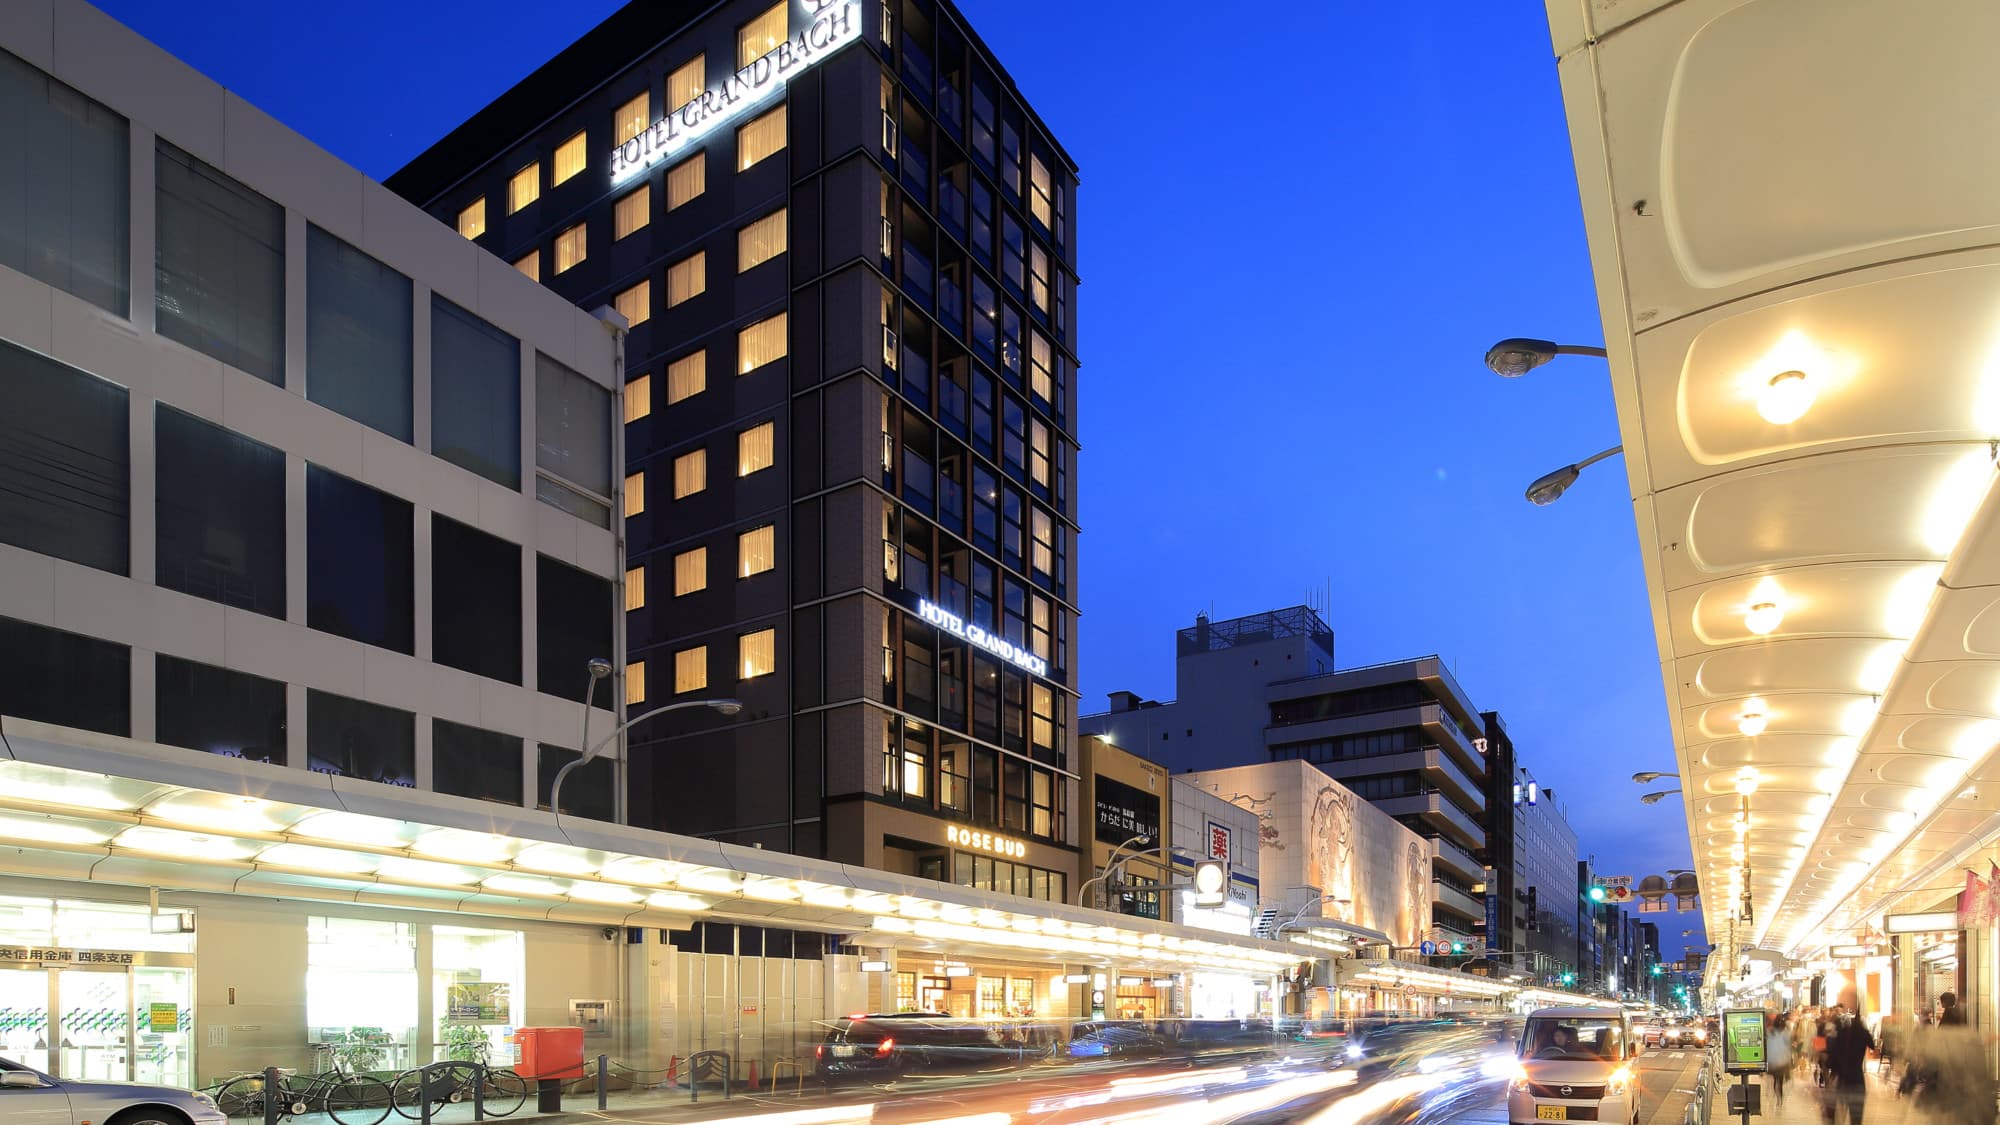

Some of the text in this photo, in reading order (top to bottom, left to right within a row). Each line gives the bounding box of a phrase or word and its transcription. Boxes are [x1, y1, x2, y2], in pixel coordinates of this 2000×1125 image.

[609, 3, 852, 177] HOTEL GRAND BACH
[919, 598, 1046, 677] HOTEL GRAND BACH
[1212, 827, 1228, 859] 薬
[78, 951, 134, 964] 四条支店
